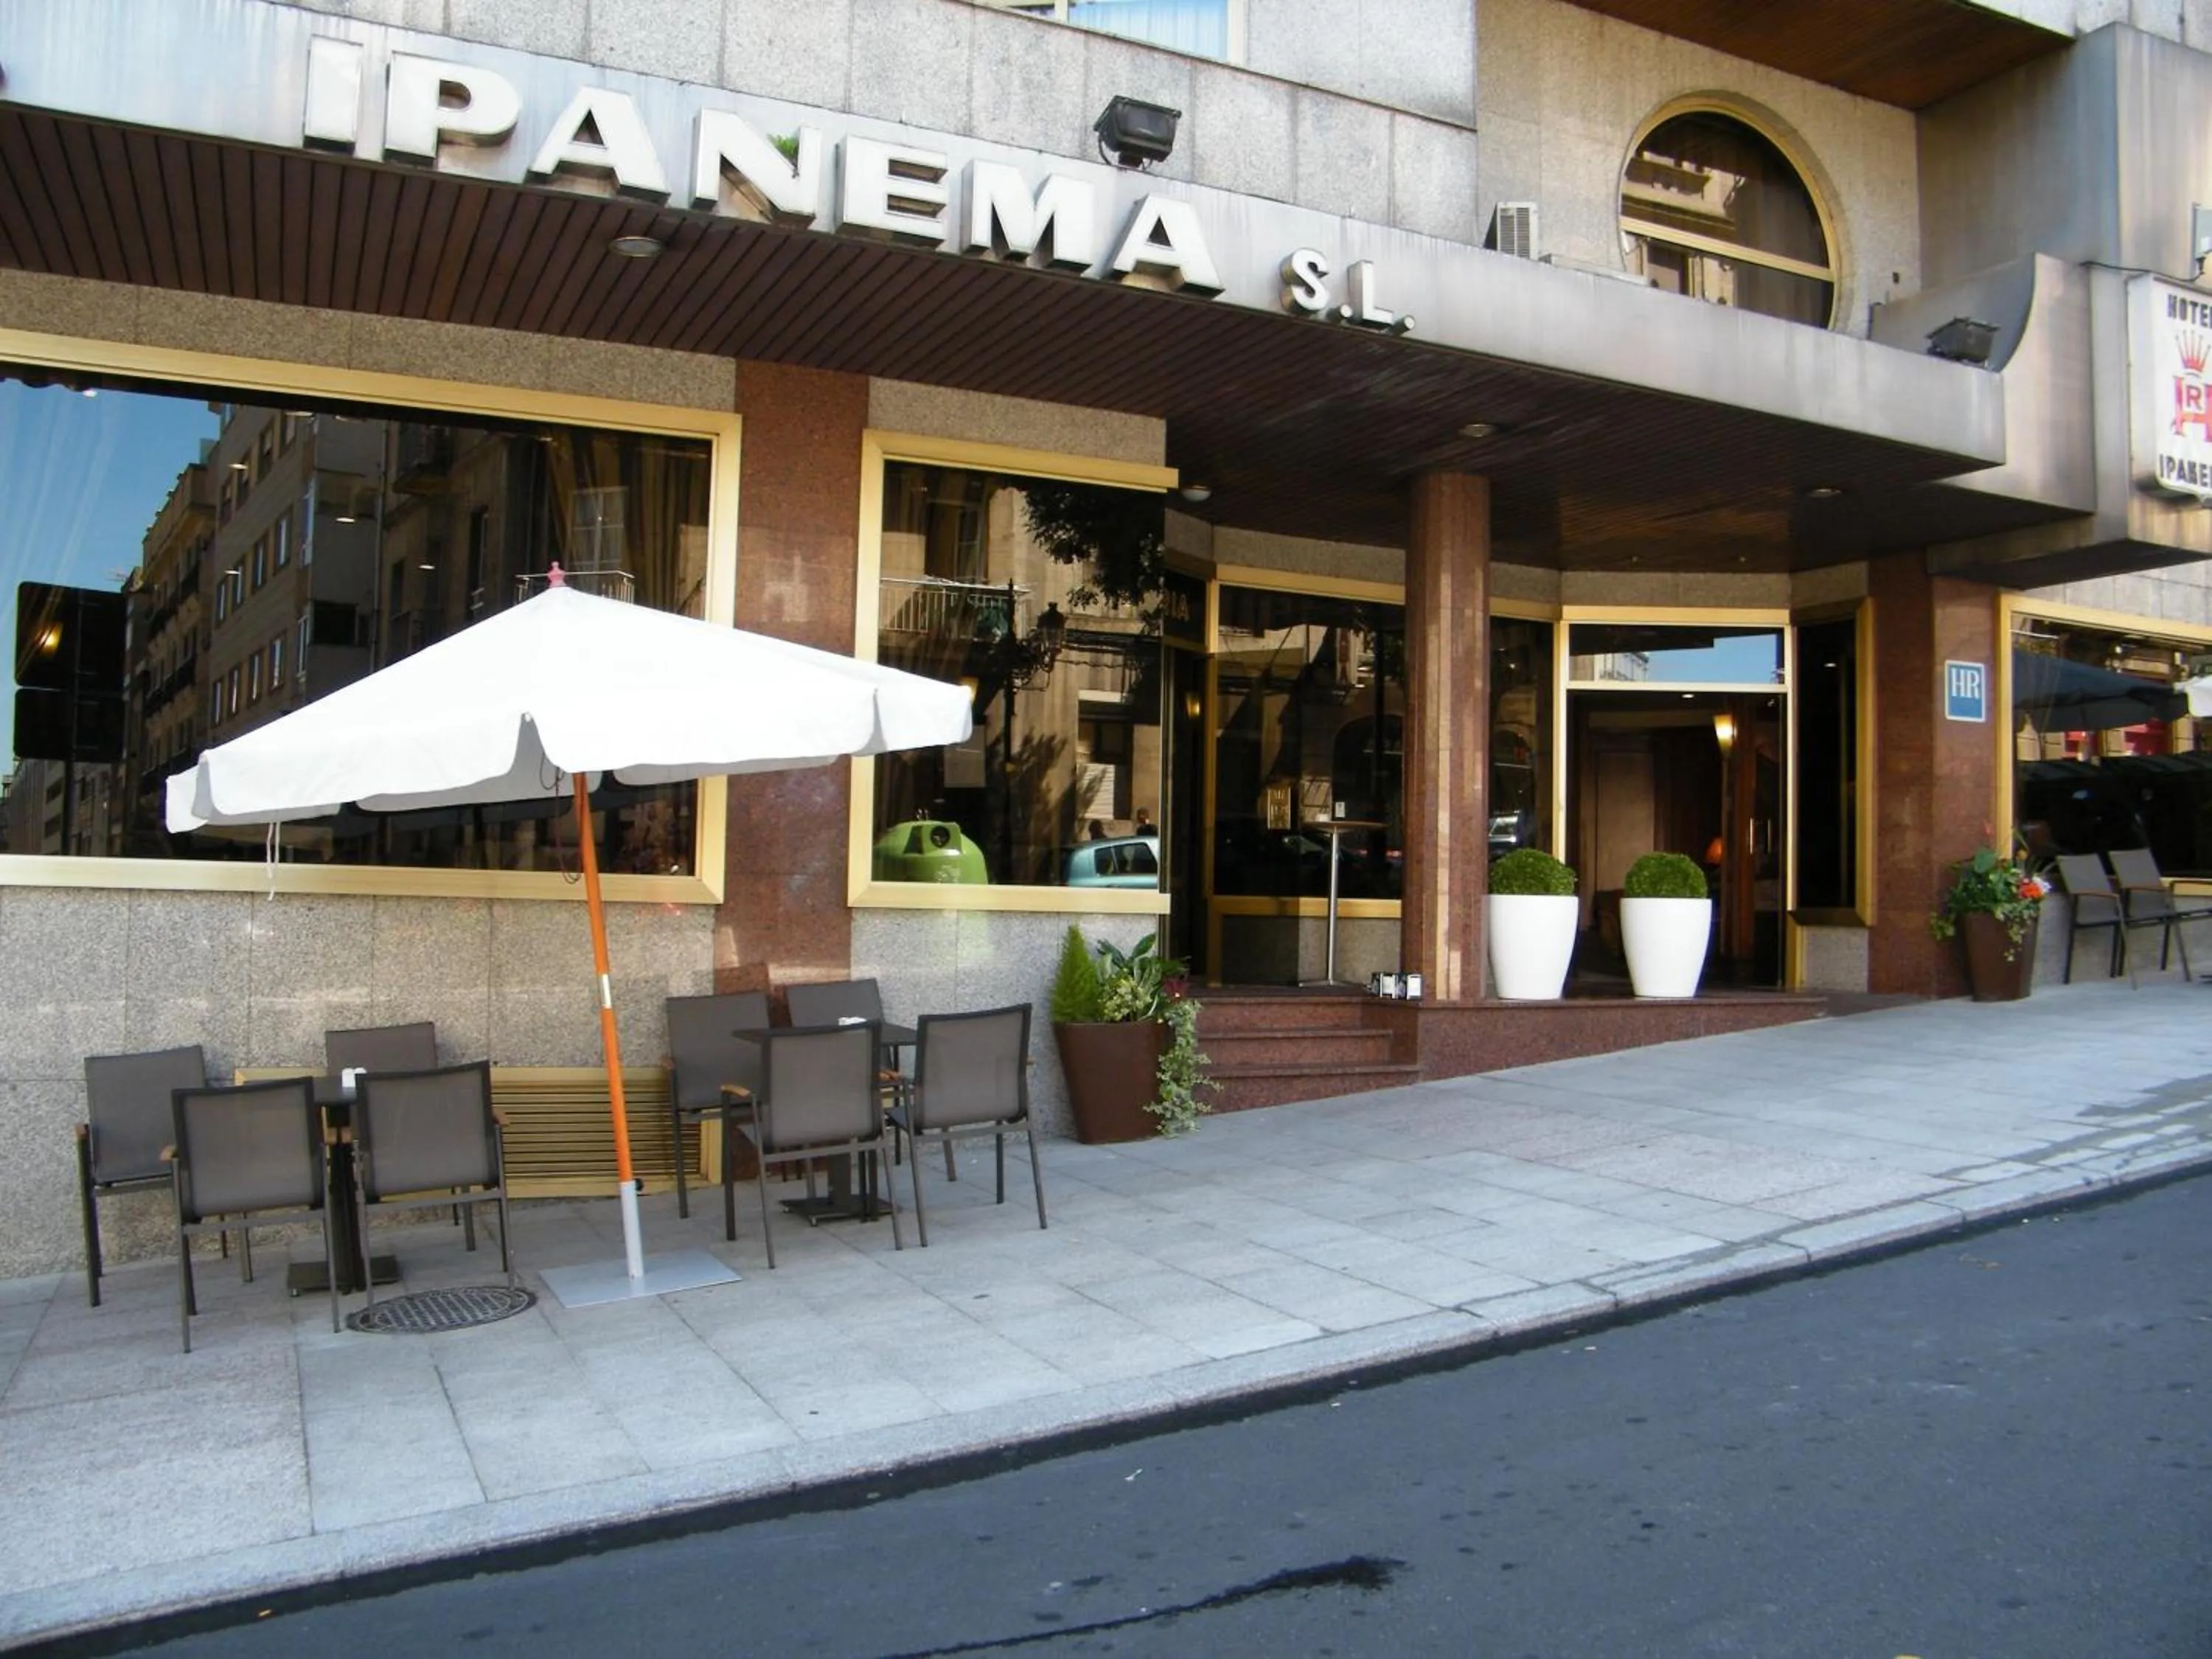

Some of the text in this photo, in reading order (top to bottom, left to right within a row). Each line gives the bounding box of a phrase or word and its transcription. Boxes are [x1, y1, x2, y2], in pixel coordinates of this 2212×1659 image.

[304, 35, 1225, 296] IPANEMA
[2168, 293, 2212, 329] HOTE
[2159, 453, 2212, 488] IPANE
[1951, 667, 1980, 700] HR
